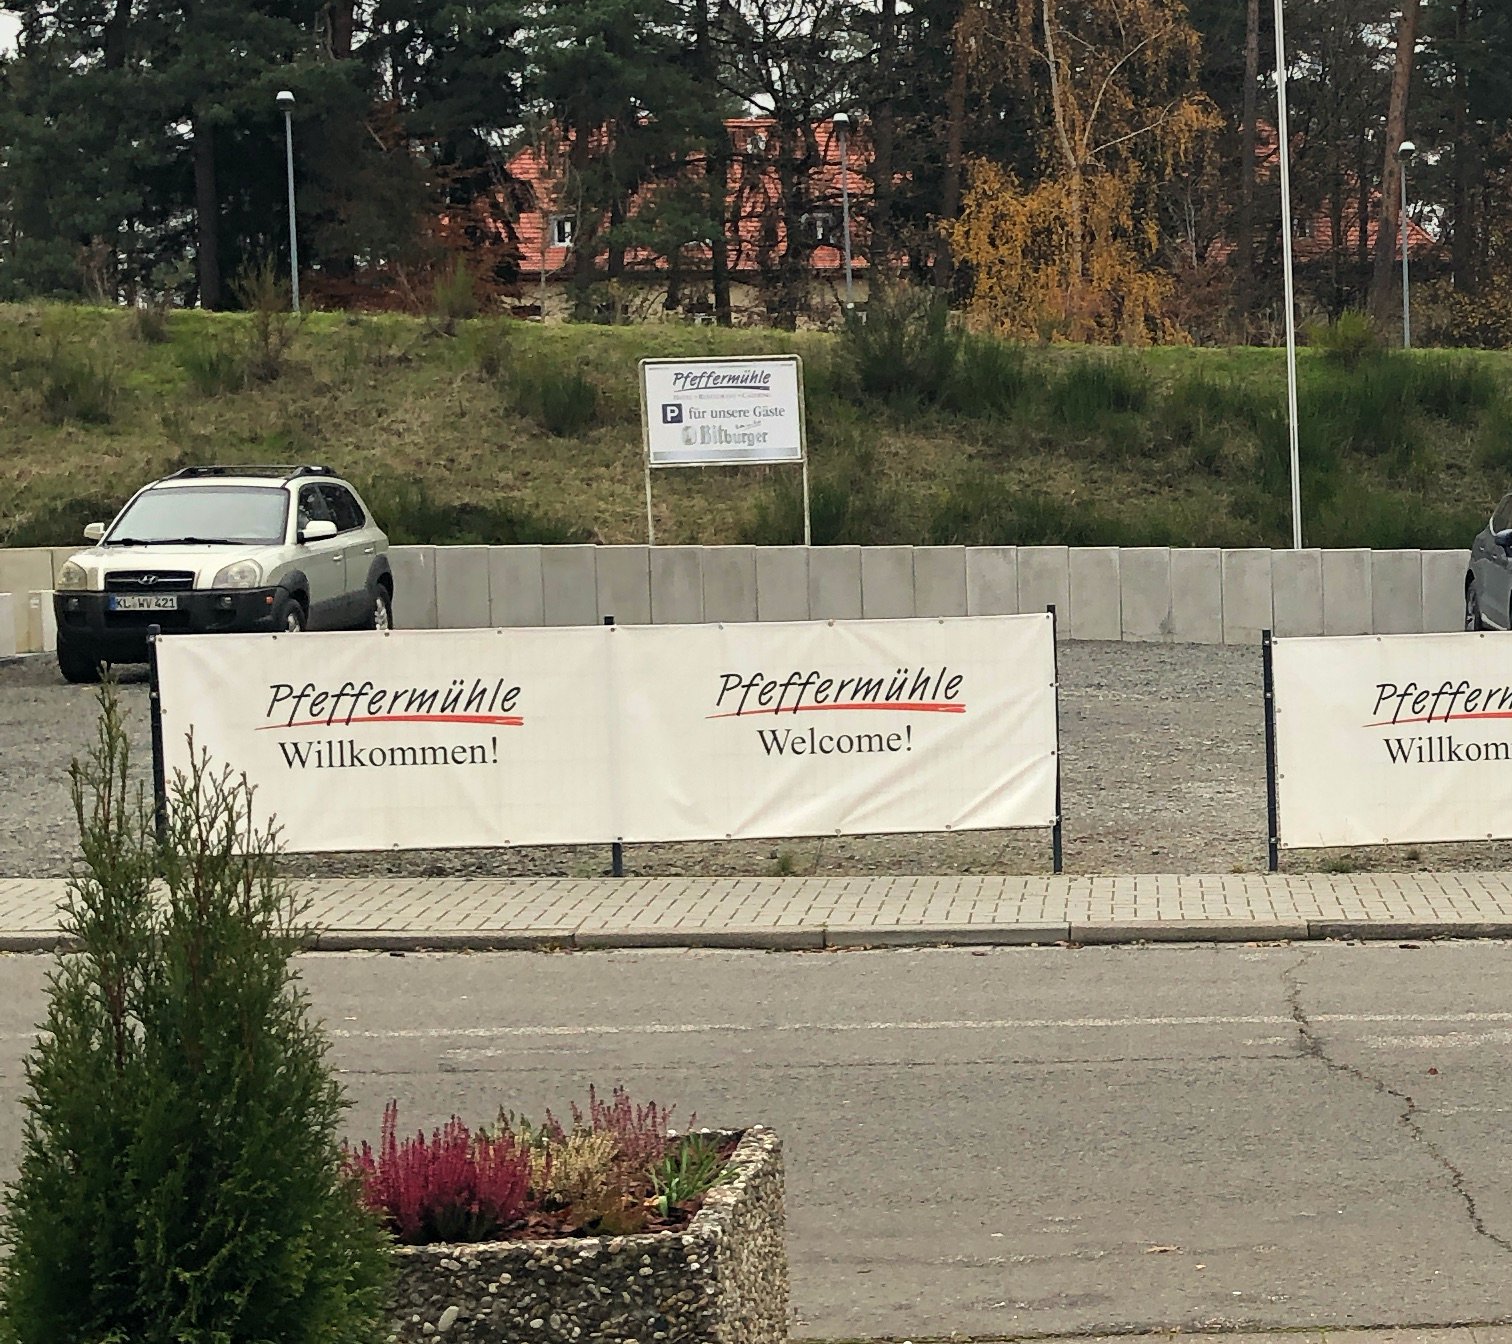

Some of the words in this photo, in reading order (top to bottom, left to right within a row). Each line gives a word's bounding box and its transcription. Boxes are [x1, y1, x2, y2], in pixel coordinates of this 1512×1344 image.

[673, 370, 771, 389] Pfeffermühle
[689, 407, 707, 419] für
[711, 408, 750, 418] unsere
[753, 406, 785, 417] Gäste
[700, 425, 768, 446] Bitburger
[155, 598, 175, 608] 421
[267, 679, 521, 727] Pfeffermühle
[717, 667, 963, 716] Pfeffermühle
[279, 737, 498, 769] Willkommen!
[758, 725, 913, 756] Welcome!
